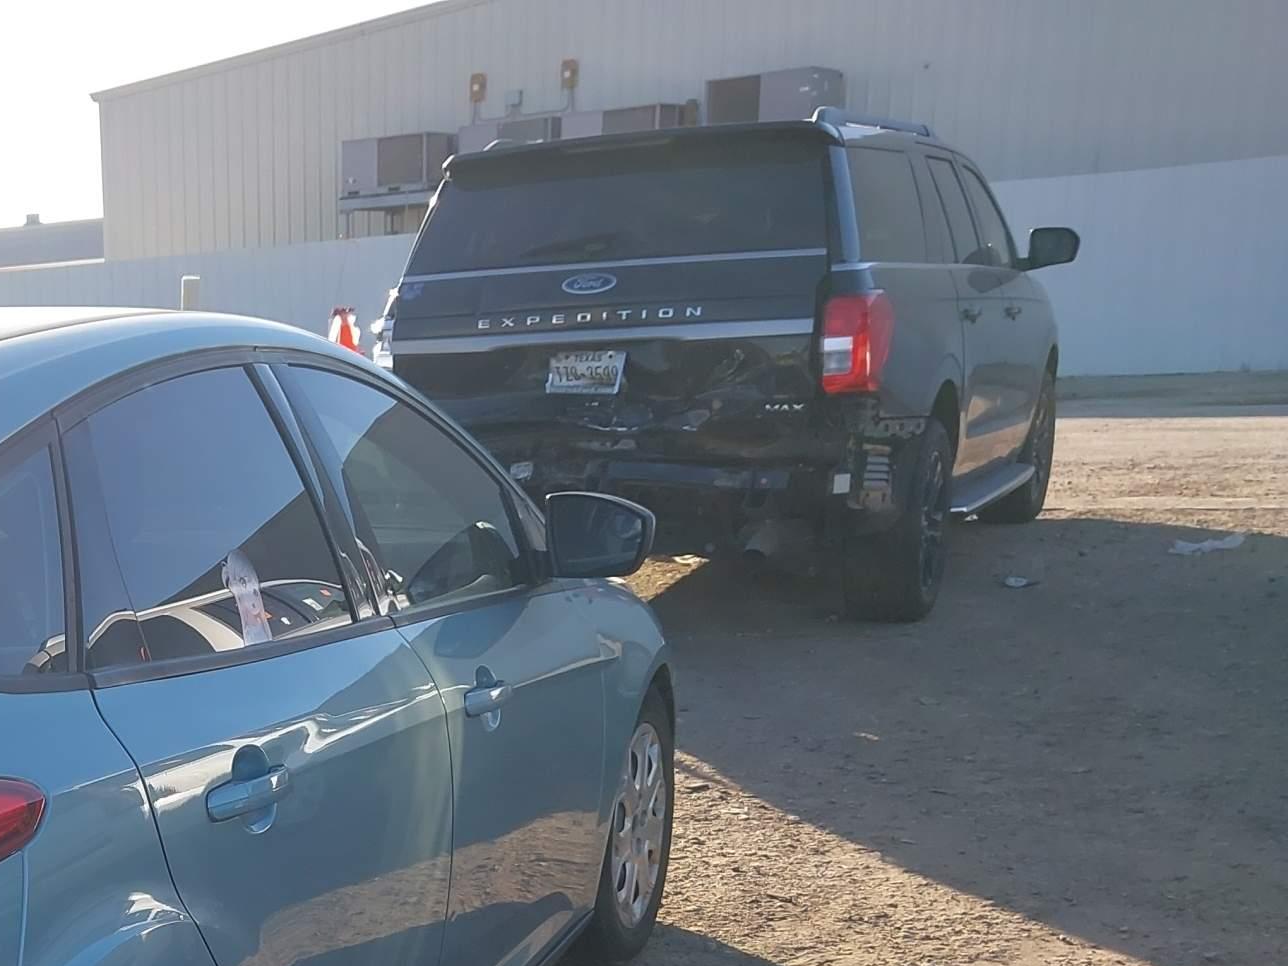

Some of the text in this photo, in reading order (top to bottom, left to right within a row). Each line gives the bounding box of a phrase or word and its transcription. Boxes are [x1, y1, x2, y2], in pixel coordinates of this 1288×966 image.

[573, 275, 604, 289] Ford
[477, 305, 704, 330] EXPEDITION
[574, 352, 603, 363] TEXAS
[764, 403, 805, 412] MAX
